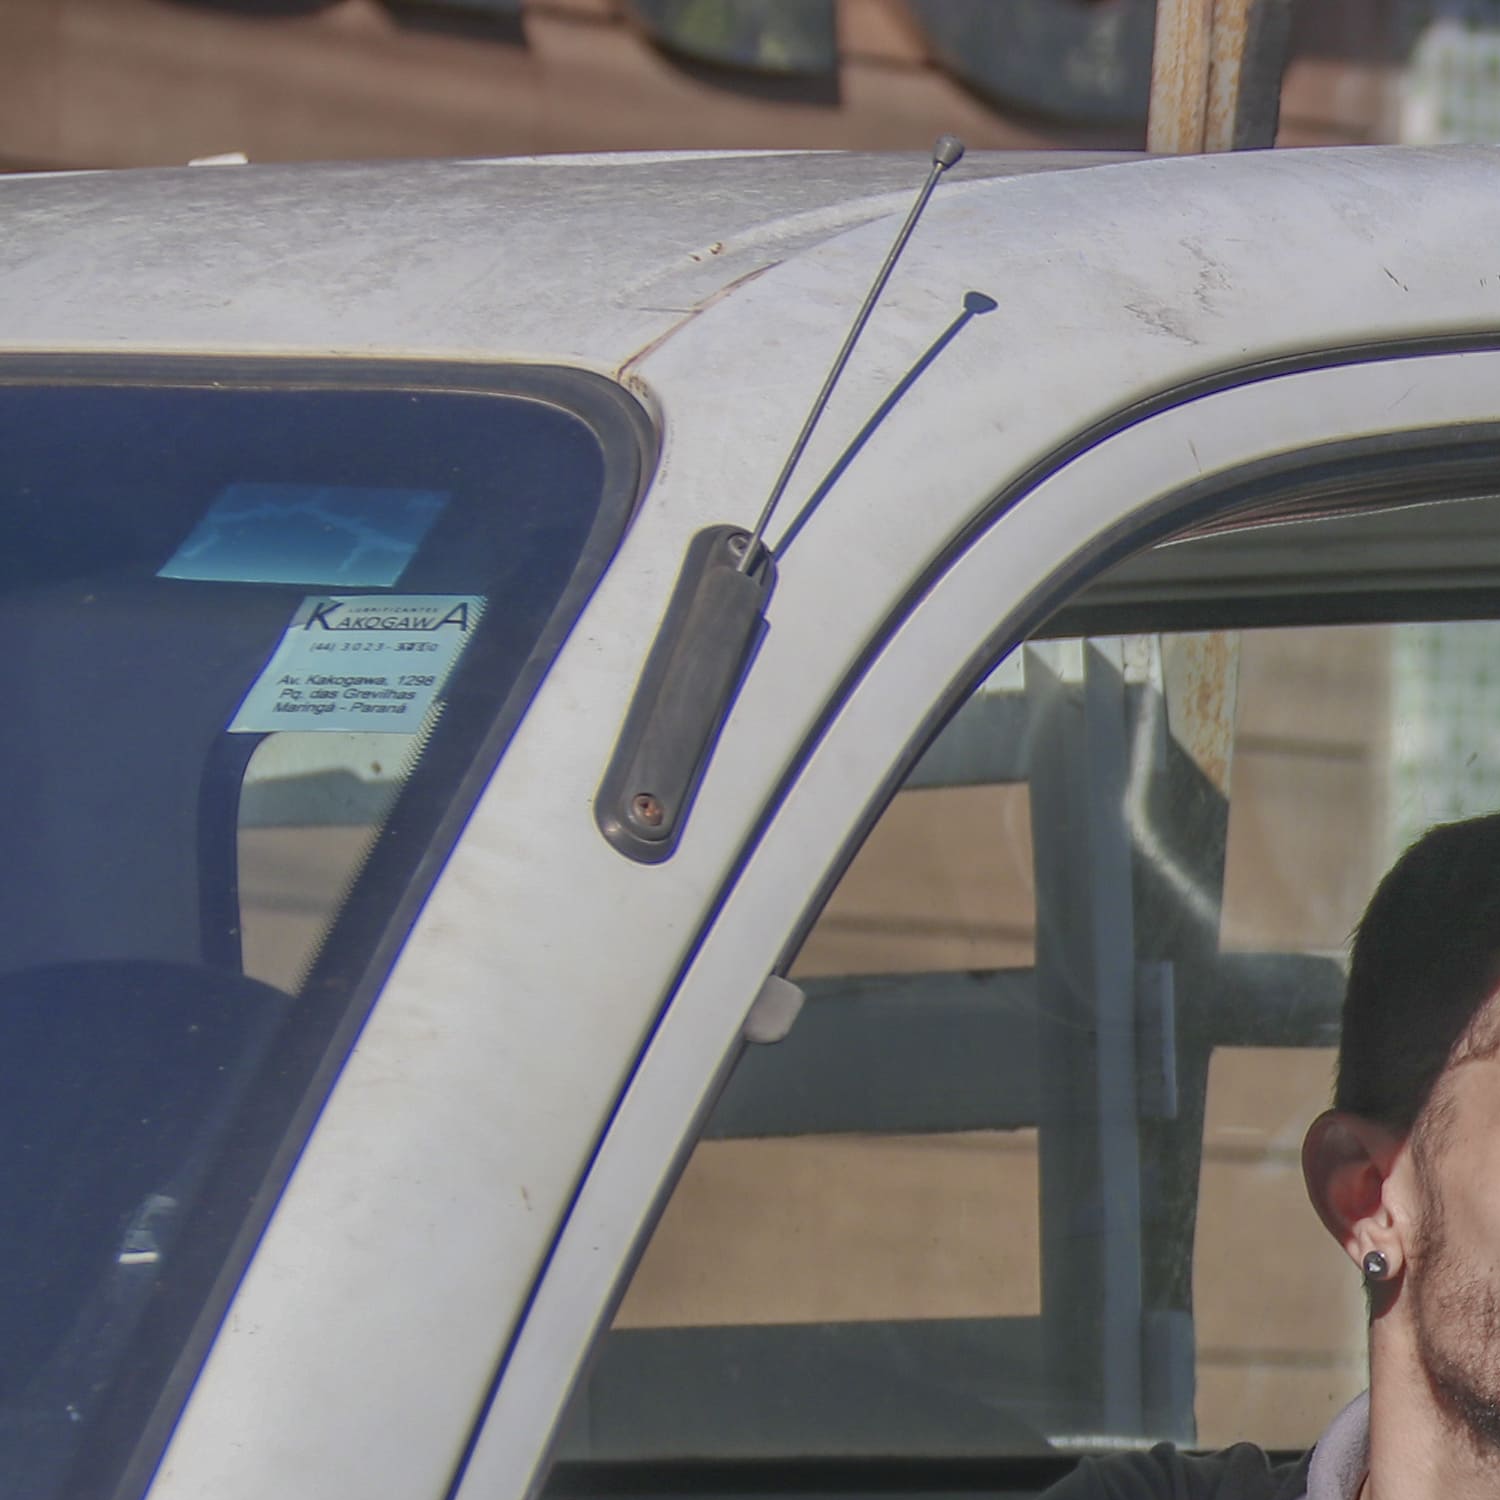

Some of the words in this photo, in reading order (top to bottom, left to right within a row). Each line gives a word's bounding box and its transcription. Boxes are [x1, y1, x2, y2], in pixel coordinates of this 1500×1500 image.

[303, 602, 469, 631] KAKOGAWA
[277, 674, 300, 686] Av.
[398, 674, 435, 687] 1298
[310, 688, 338, 699] das
[349, 702, 408, 714] Paraná
